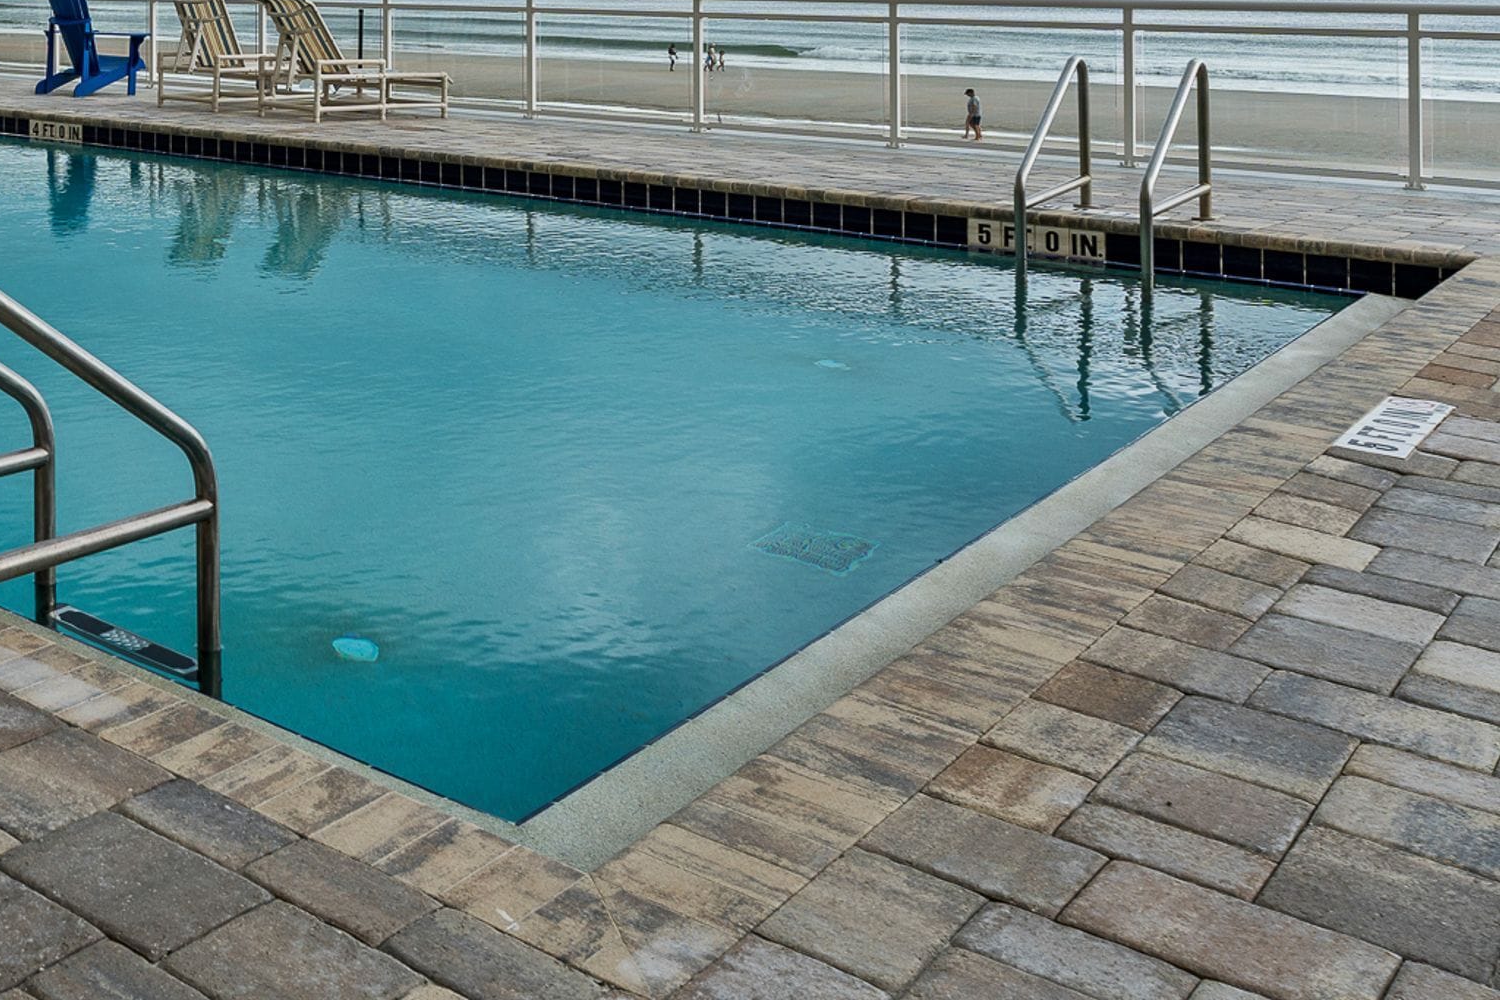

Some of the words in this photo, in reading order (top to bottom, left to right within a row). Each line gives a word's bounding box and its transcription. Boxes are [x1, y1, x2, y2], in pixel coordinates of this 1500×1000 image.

[32, 122, 39, 136] 4
[58, 125, 66, 138] 0
[978, 223, 991, 245] 5
[1045, 230, 1060, 252] 0
[1071, 233, 1103, 258] IN.
